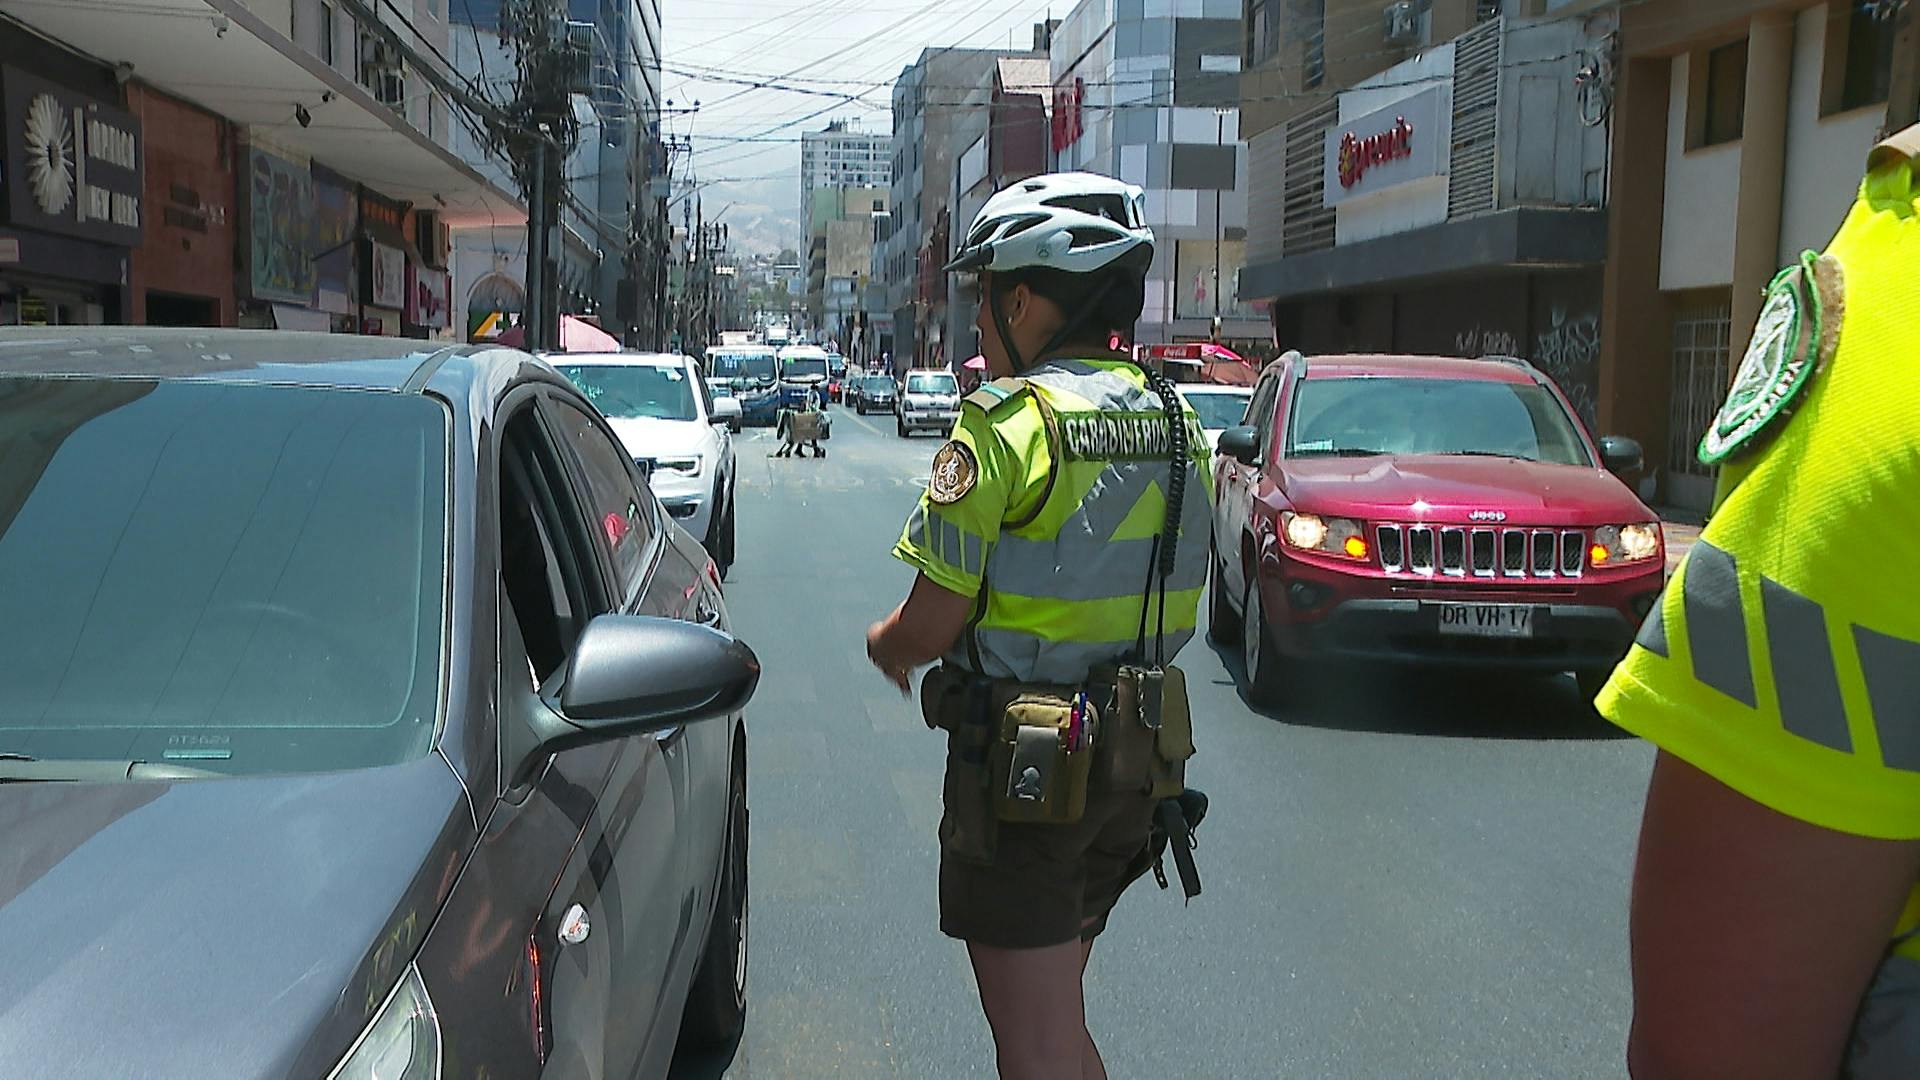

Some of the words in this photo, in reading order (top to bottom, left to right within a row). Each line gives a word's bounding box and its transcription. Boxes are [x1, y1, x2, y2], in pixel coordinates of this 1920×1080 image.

[1065, 417, 1168, 456] CARABINEROS
[1468, 509, 1506, 521] Jeep
[1441, 605, 1468, 625] DR
